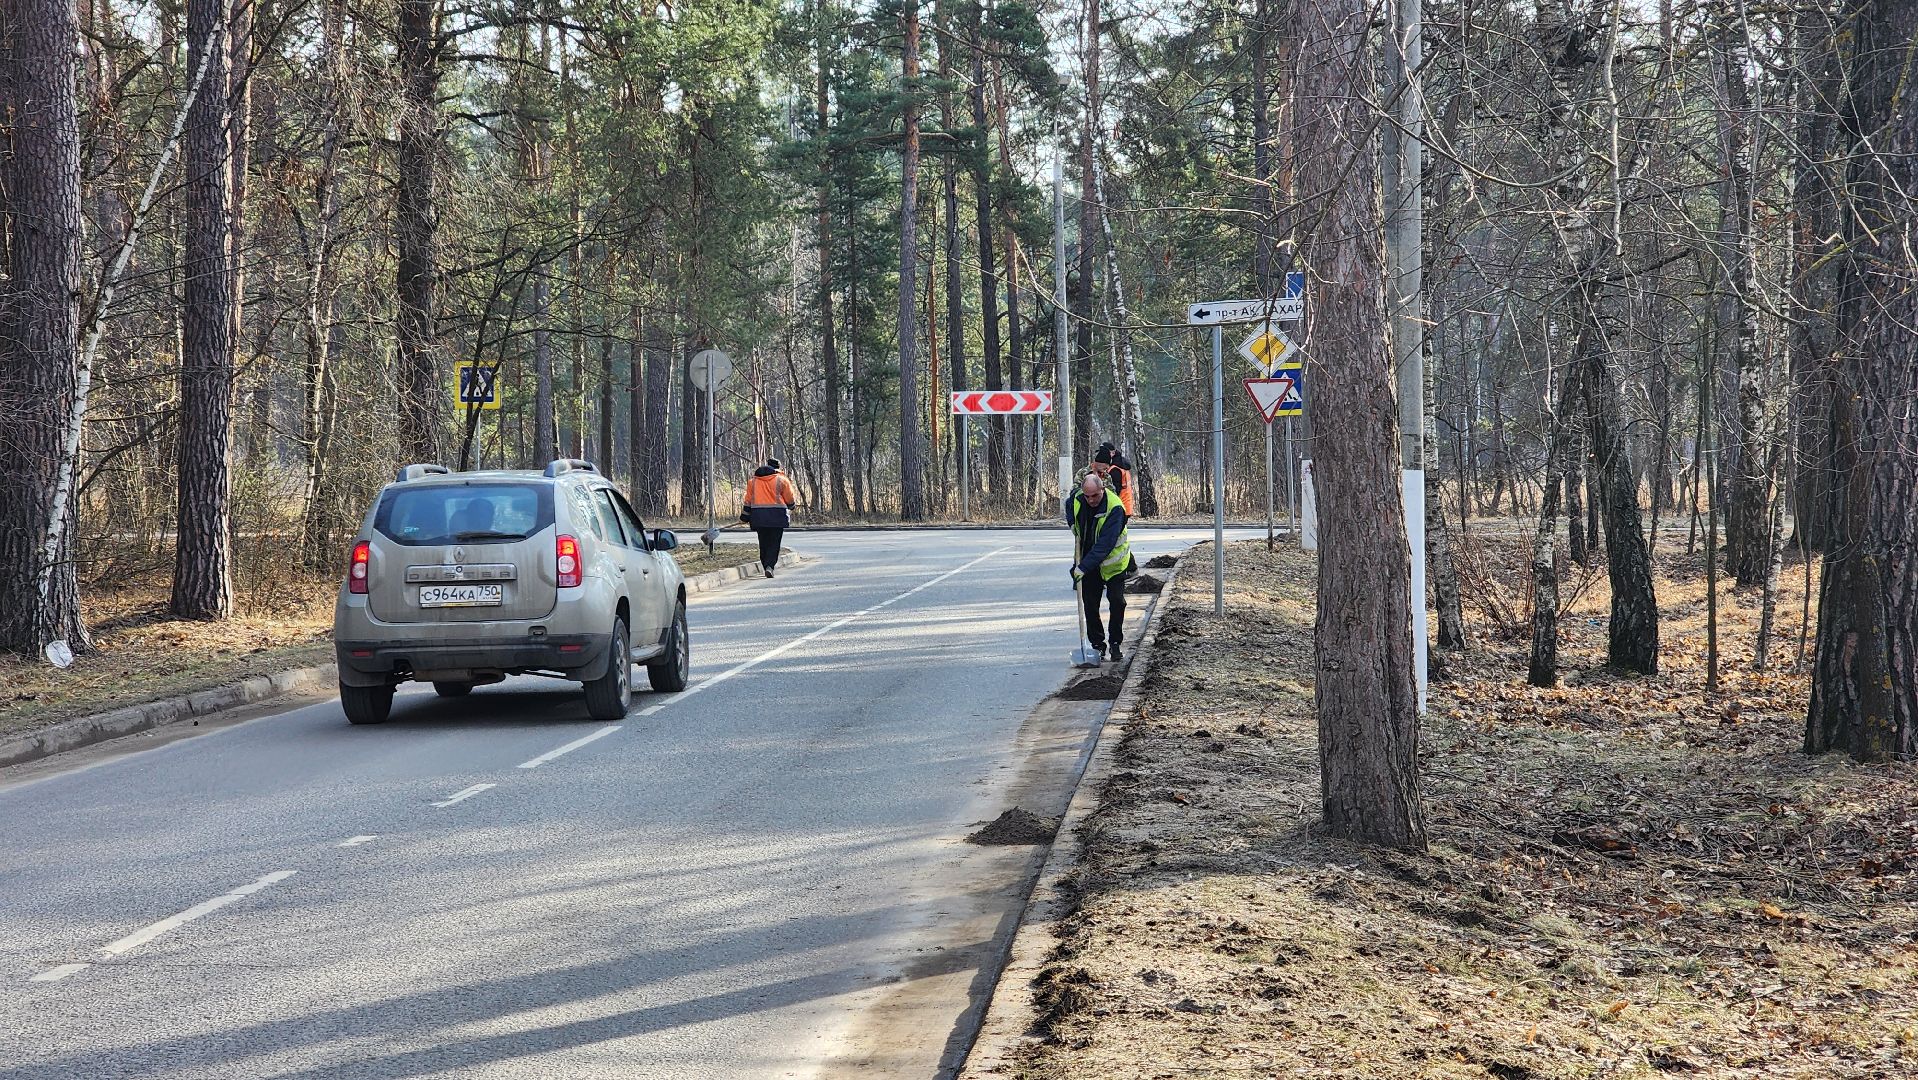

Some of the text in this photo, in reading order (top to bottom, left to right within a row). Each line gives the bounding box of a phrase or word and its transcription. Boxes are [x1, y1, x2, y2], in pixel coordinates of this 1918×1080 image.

[409, 571, 511, 580] DUSTER
[423, 585, 498, 601] С964КА 750
